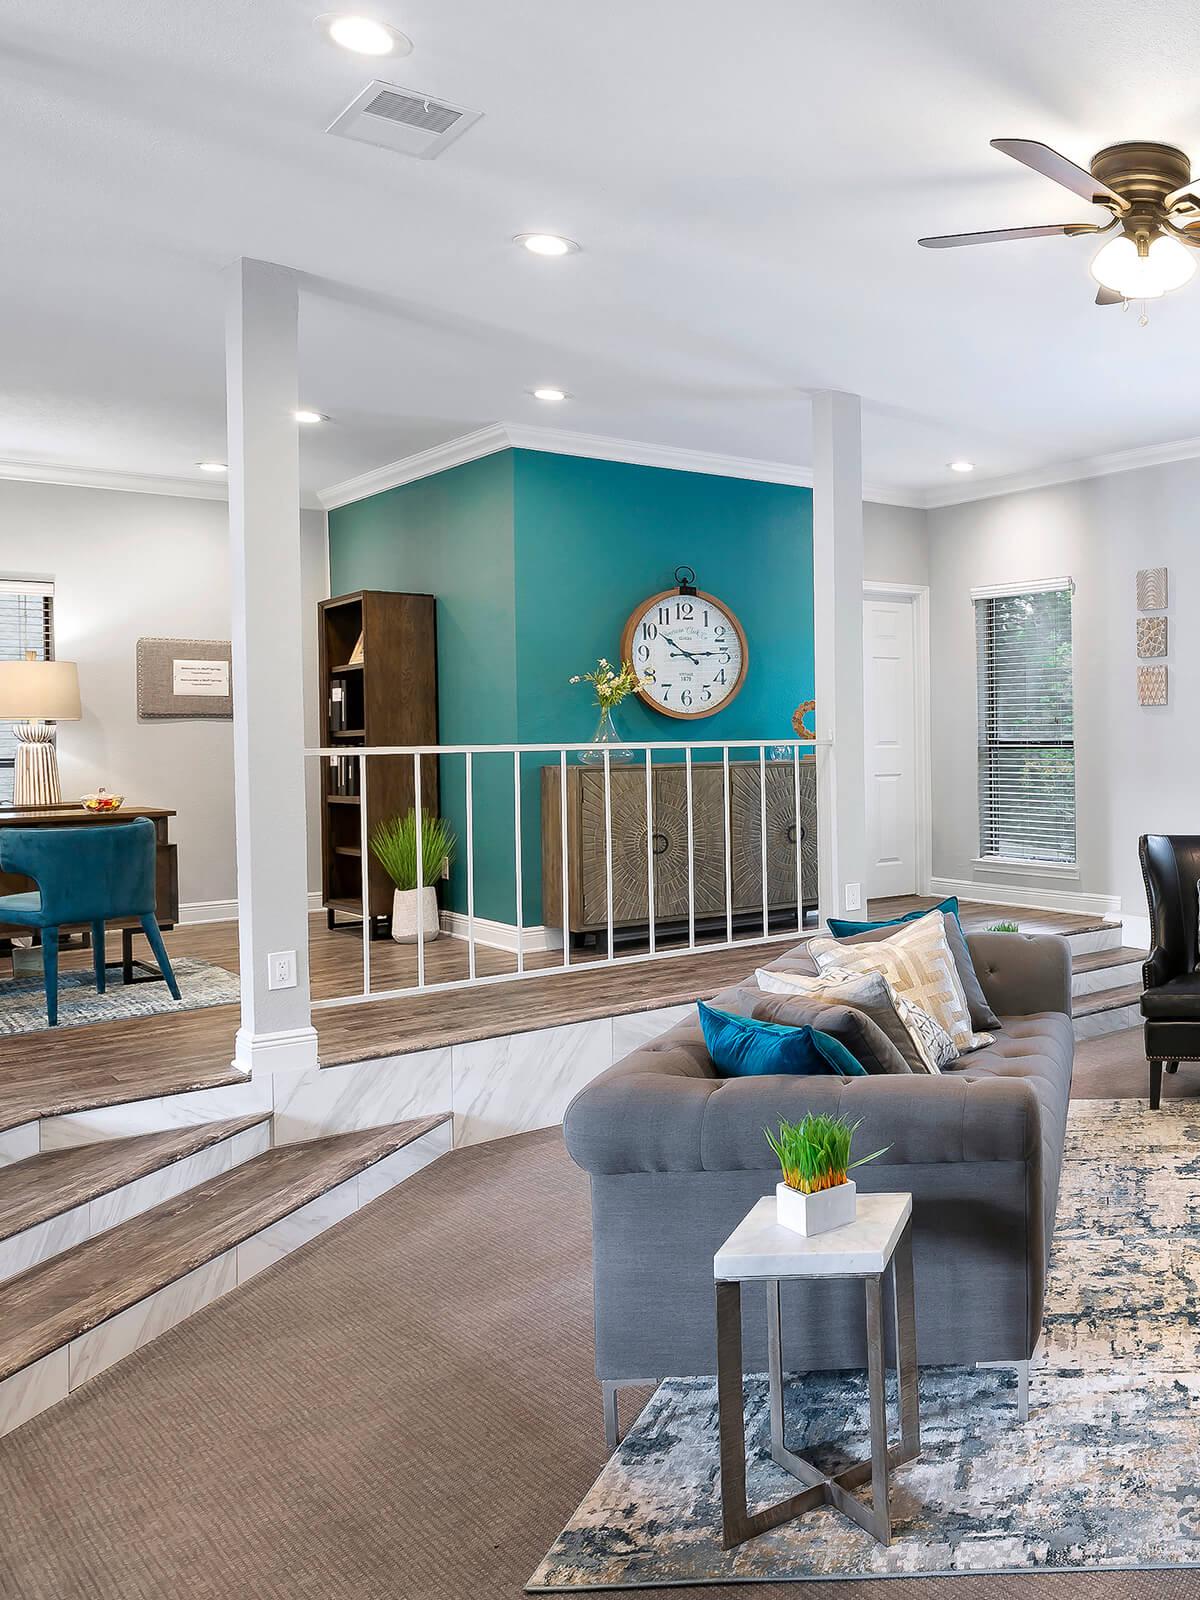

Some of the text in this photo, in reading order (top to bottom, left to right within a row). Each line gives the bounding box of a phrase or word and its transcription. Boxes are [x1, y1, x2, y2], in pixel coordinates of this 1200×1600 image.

[659, 607, 670, 625] 11
[676, 602, 694, 620] 12
[702, 610, 709, 628] 1
[642, 622, 658, 641] 10
[714, 625, 726, 643] 2
[637, 644, 650, 662] 9
[718, 647, 731, 664] 3
[712, 668, 727, 685] 4
[661, 683, 673, 701] 7
[680, 689, 693, 707] 6
[700, 685, 712, 702] 5
